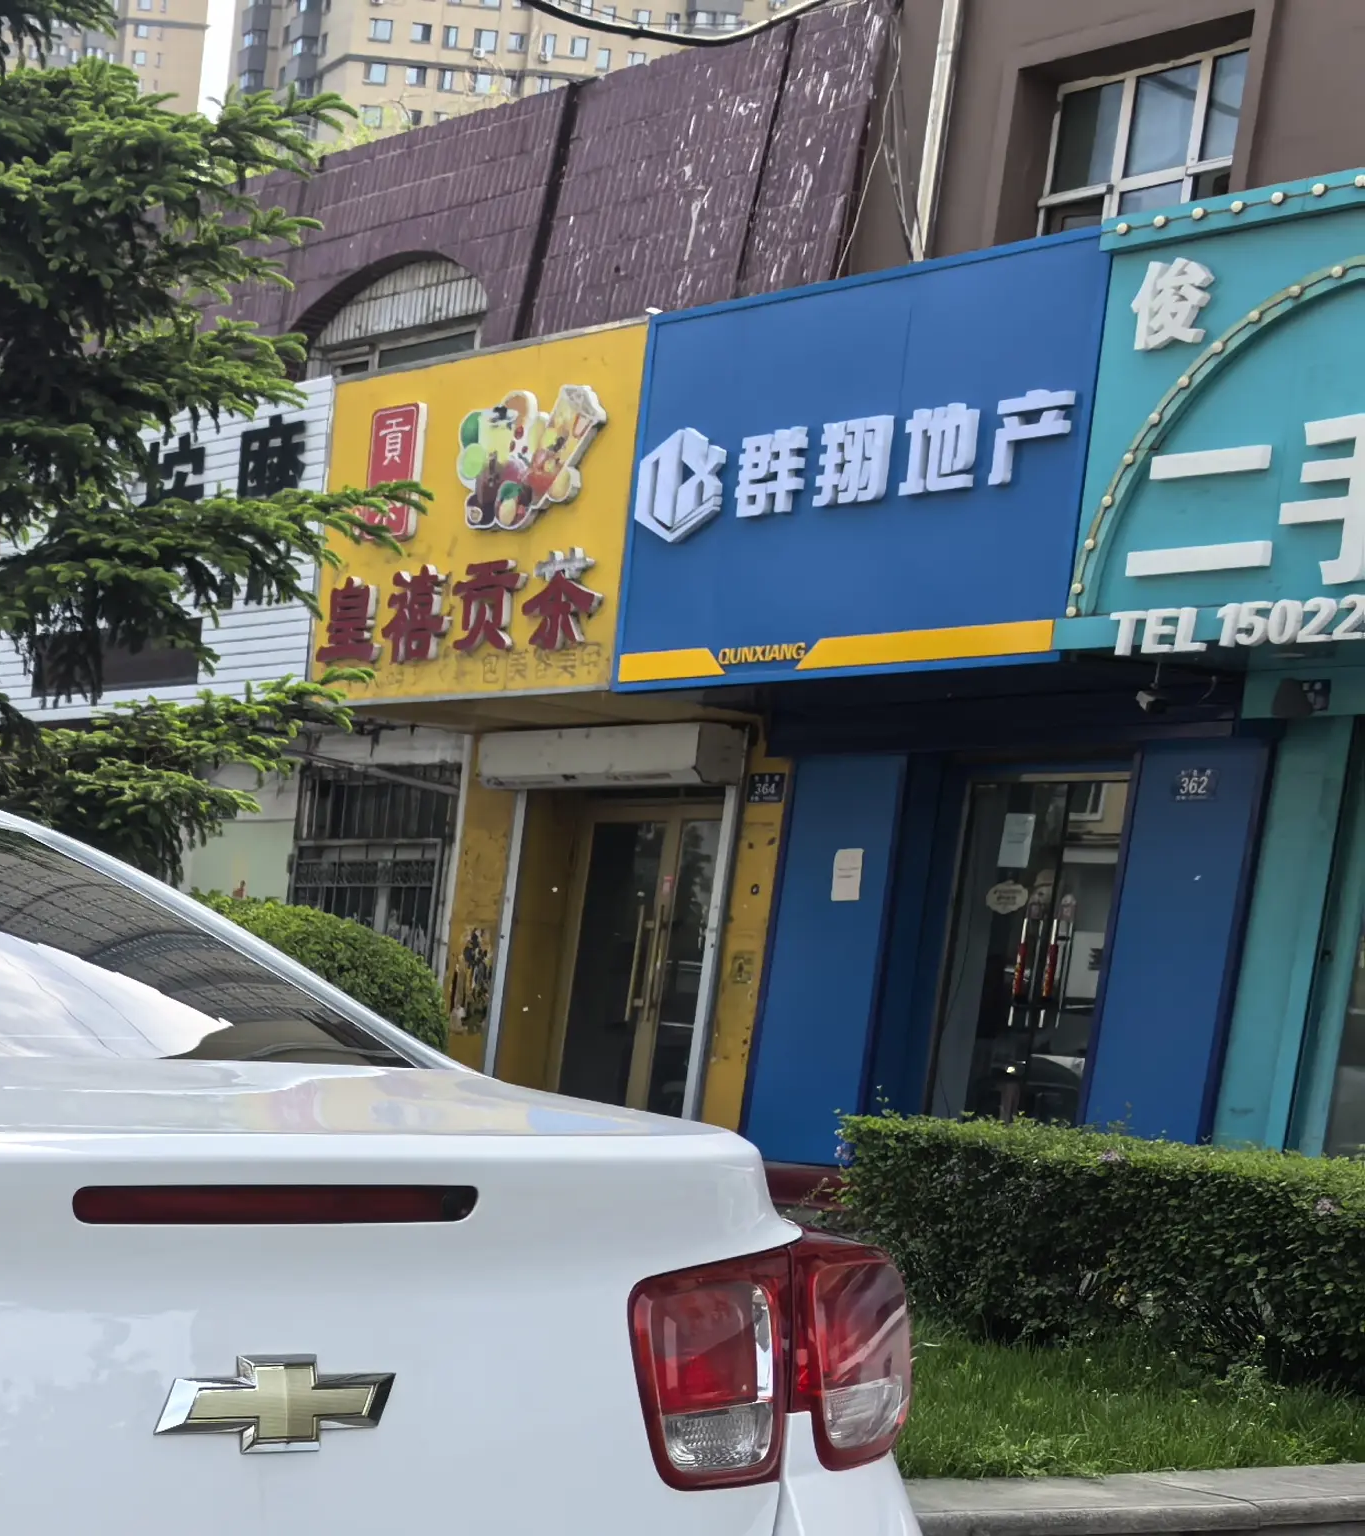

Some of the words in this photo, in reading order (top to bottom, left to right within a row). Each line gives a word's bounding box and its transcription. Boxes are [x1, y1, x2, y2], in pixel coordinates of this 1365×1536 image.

[1130, 256, 1216, 352] 俊
[734, 388, 1076, 518] 群翔地产
[316, 546, 605, 665] 皇禧贡茶
[1110, 606, 1207, 656] TEL
[718, 641, 807, 665] QUNXIANG
[1179, 776, 1209, 794] 362
